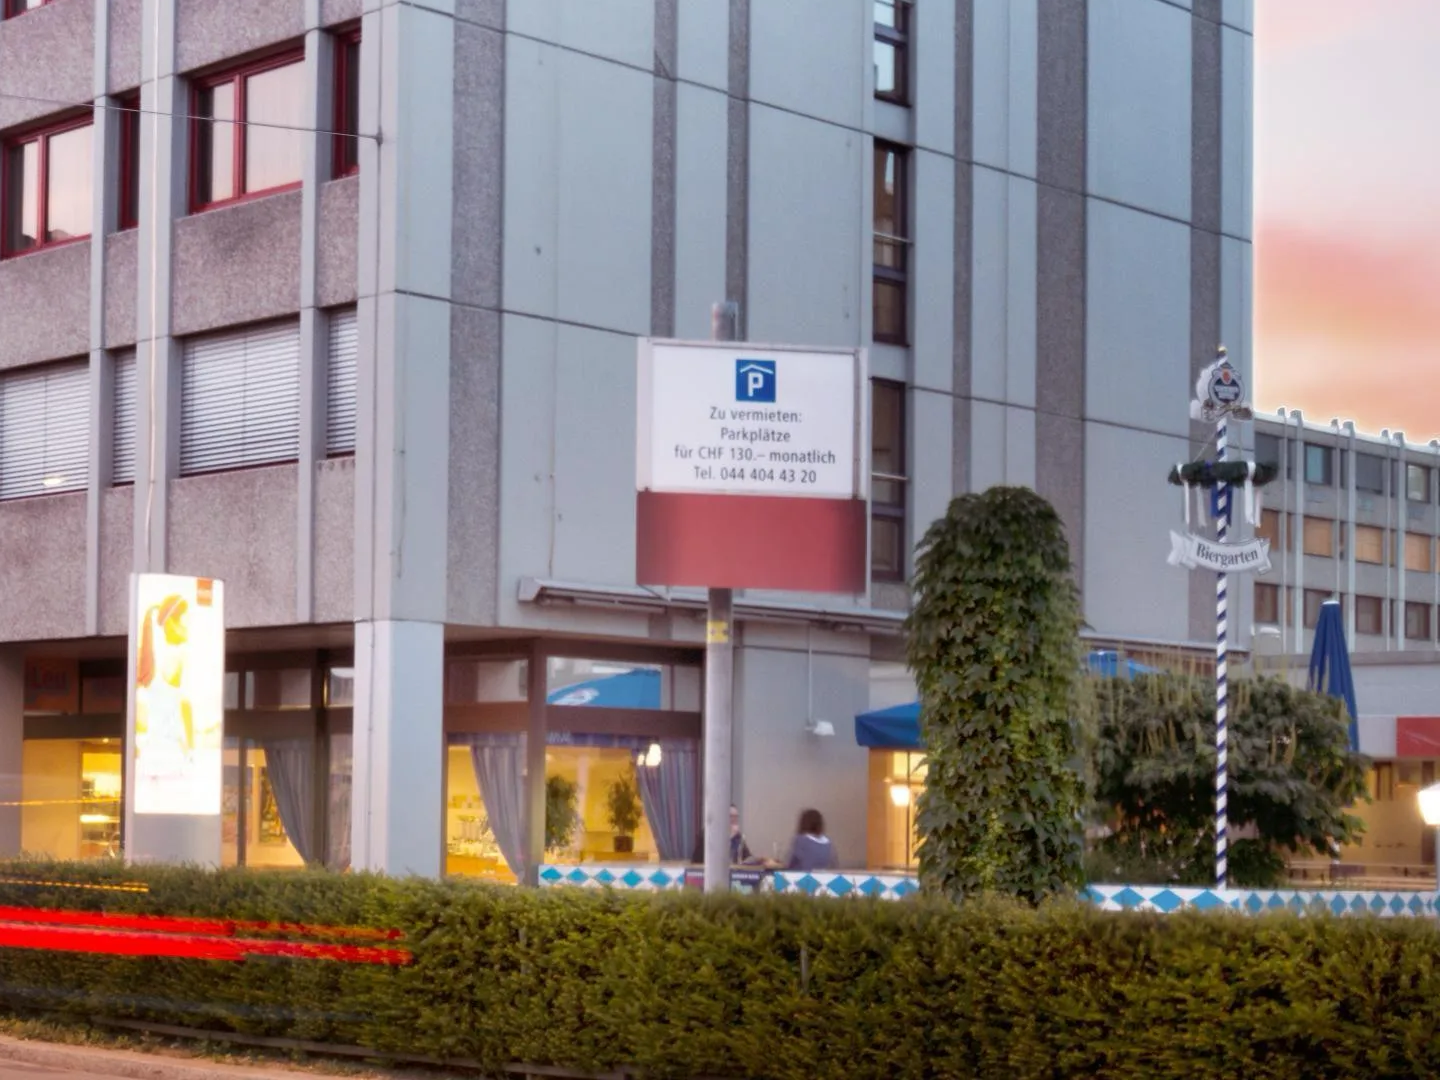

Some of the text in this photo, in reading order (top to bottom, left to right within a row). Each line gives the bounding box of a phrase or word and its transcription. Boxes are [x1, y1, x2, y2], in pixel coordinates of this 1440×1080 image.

[747, 372, 764, 397] P
[710, 406, 803, 423] Zu vermieten:
[720, 427, 792, 444] Parkplätze
[674, 445, 693, 459] für
[698, 446, 724, 460] CHF
[769, 449, 837, 465] monatlich
[694, 466, 818, 484] Tel. 044 404 43 20
[1195, 541, 1259, 567] Biergarten
